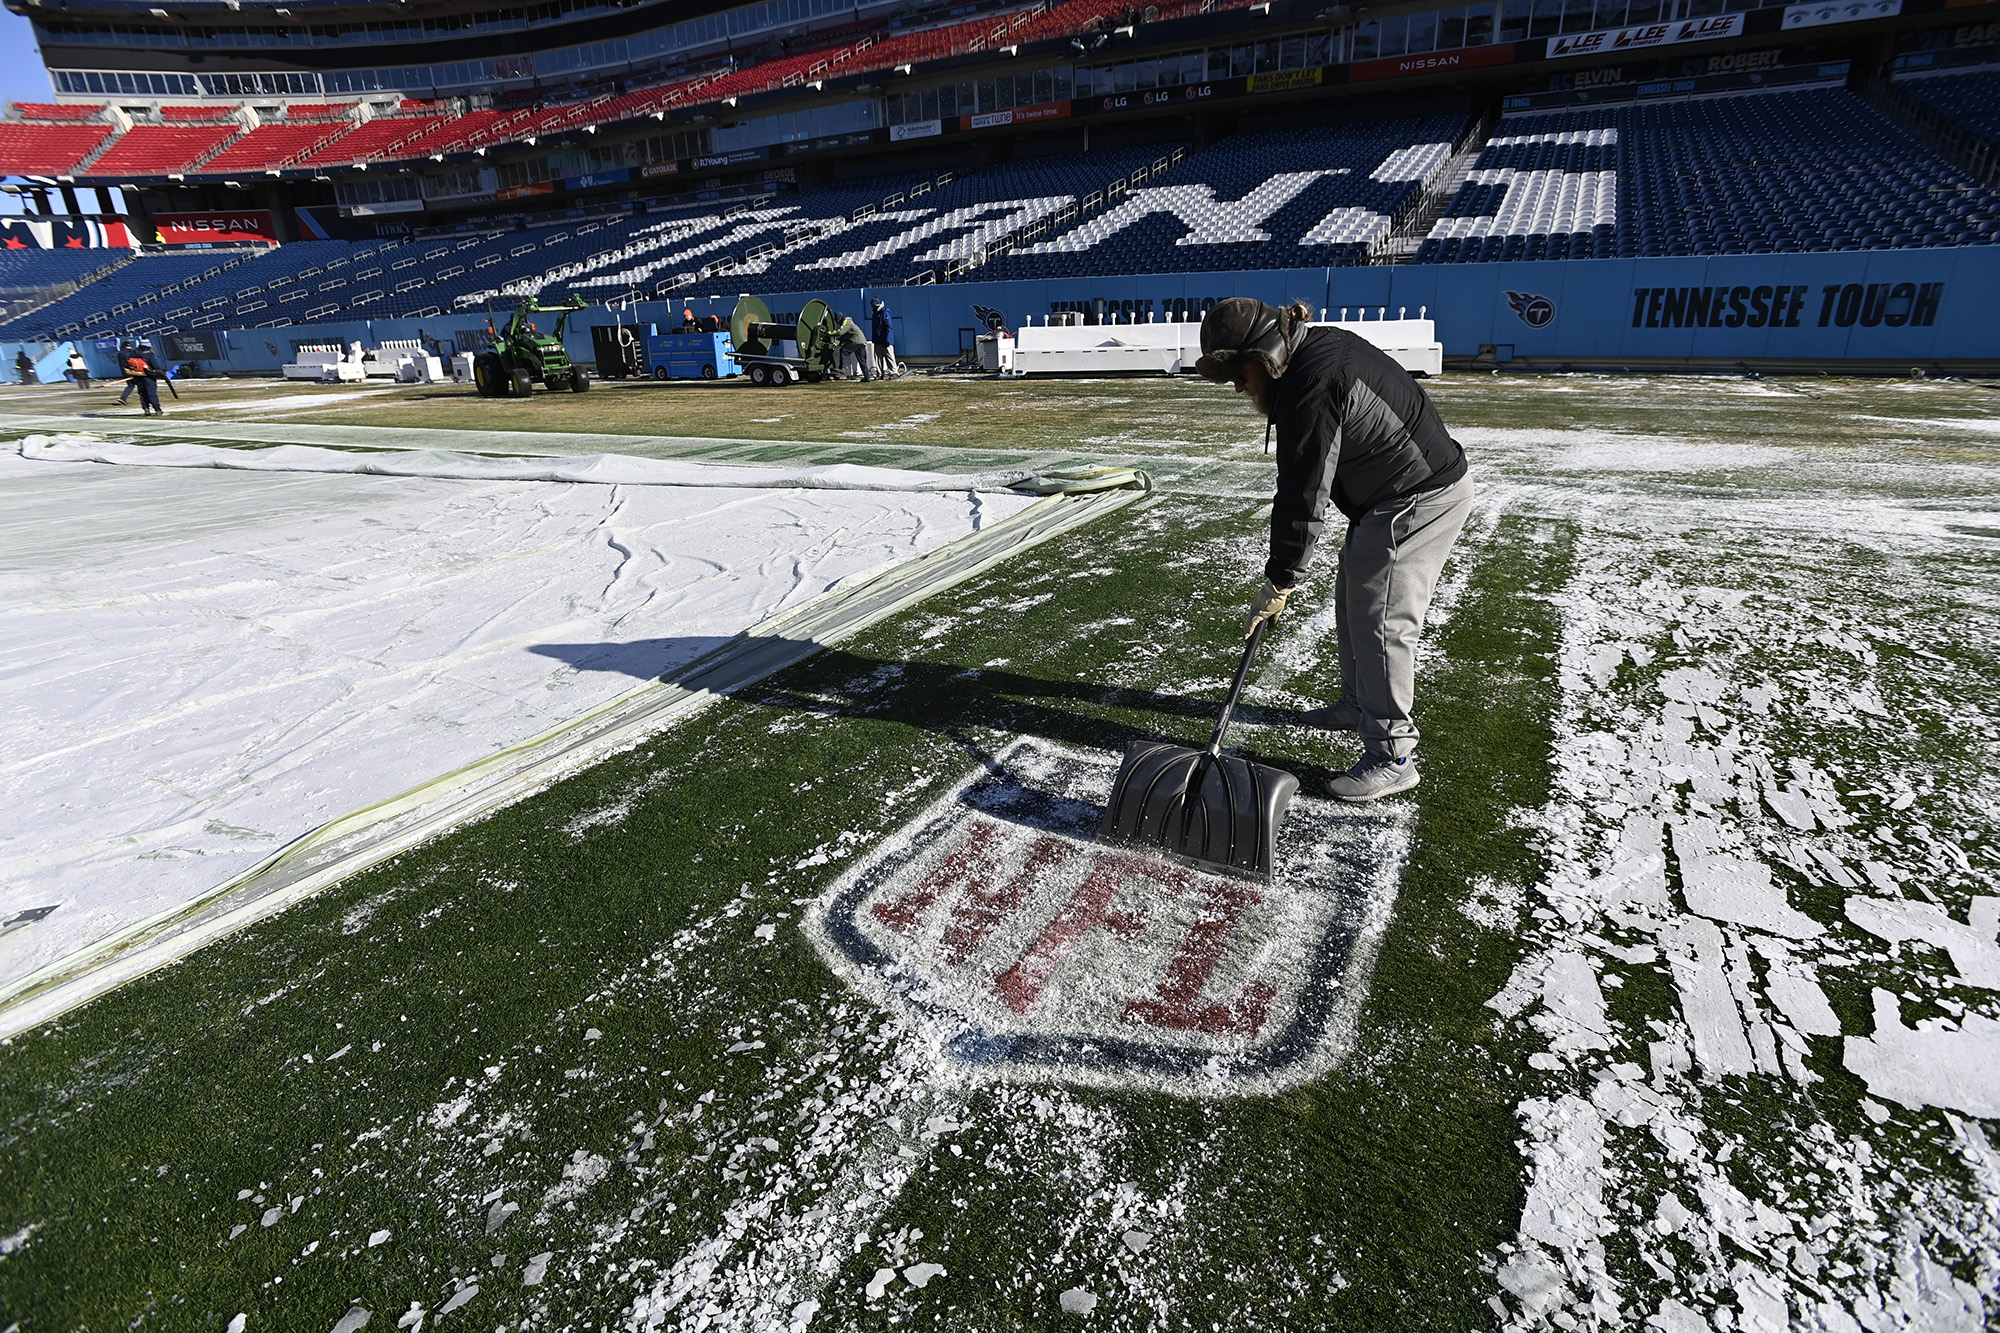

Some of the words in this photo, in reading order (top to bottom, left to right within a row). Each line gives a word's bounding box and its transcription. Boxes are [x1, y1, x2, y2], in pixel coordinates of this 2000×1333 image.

[1698, 15, 1738, 33] LEE
[1633, 25, 1670, 40] LEE
[1694, 30, 1728, 40] COMPANY
[1954, 24, 2000, 44] EAR
[1572, 33, 1607, 48] LEE
[1630, 38, 1662, 48] COMPANY
[1569, 46, 1599, 55] COMPANY
[1400, 56, 1460, 70] NISSAN
[1708, 49, 1784, 71] ROBERT
[1575, 68, 1622, 85] ELVIN
[1156, 91, 1168, 102] LG
[1198, 85, 1211, 97] LG
[1115, 97, 1127, 107] LG
[1016, 112, 1025, 120] It's
[1026, 110, 1042, 119] twine
[700, 156, 728, 168] RJYoung
[648, 163, 677, 175] GATORADE
[763, 168, 795, 180] GEORGE
[705, 178, 720, 188] KEN
[171, 218, 258, 232] NISSAN
[1162, 297, 1231, 323] TOU
[1631, 285, 1808, 328] TENNESSEE
[870, 819, 1278, 1038] NFL
